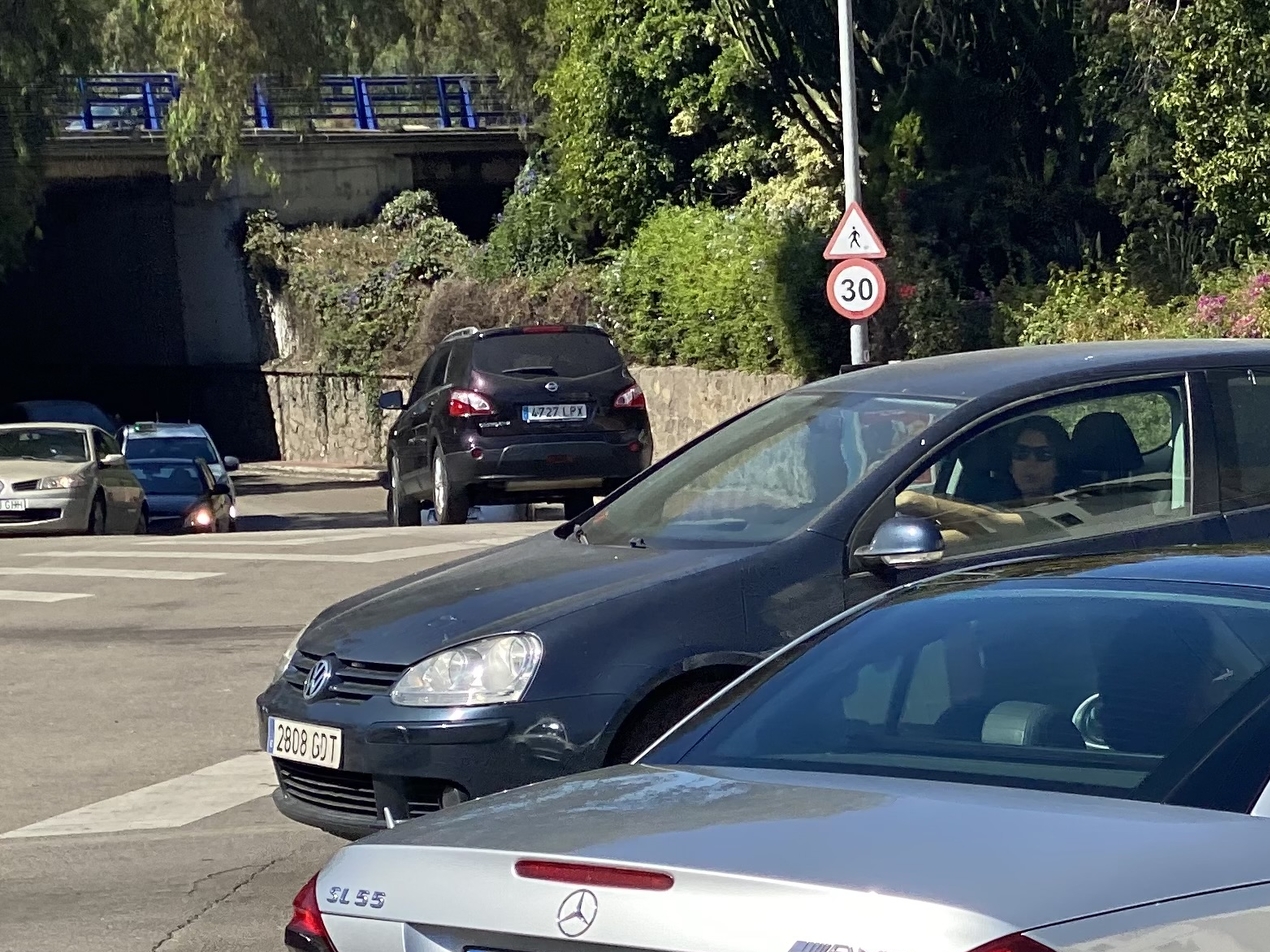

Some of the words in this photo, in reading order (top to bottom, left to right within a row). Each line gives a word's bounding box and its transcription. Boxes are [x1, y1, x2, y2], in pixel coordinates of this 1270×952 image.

[841, 278, 873, 302] 30
[532, 407, 559, 417] 4727
[562, 406, 583, 417] LPX
[277, 724, 307, 756] 2808
[312, 732, 337, 763] GDT
[326, 886, 350, 905] SL
[354, 890, 386, 909] 55
